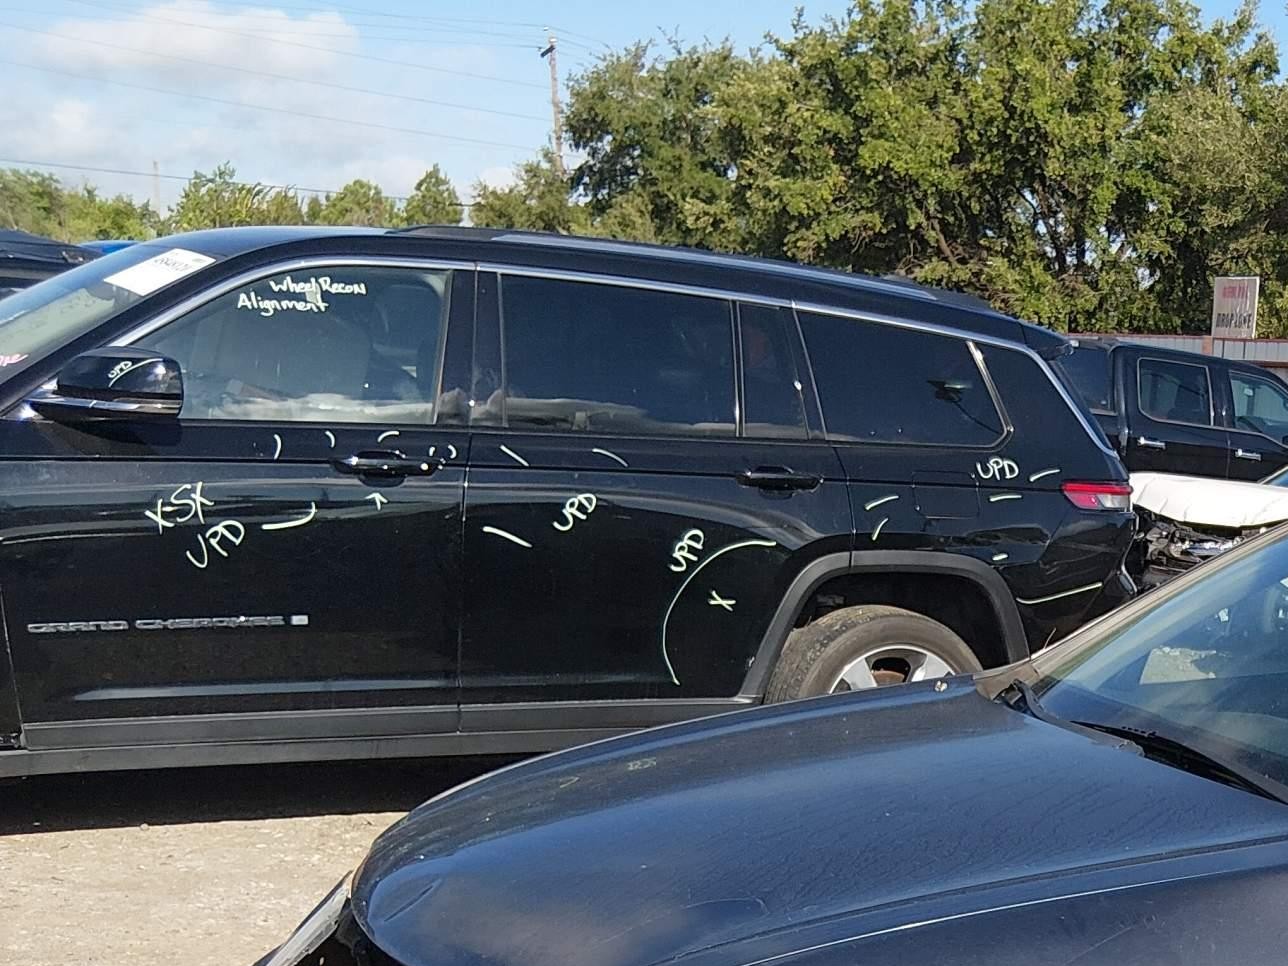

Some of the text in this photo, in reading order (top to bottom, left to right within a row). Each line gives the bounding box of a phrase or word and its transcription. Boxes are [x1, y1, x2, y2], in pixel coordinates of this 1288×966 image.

[270, 276, 317, 293] Wheel
[237, 291, 329, 317] Alignment
[976, 457, 1019, 481] UPD
[552, 492, 597, 531] UPD
[668, 528, 704, 572] UPD
